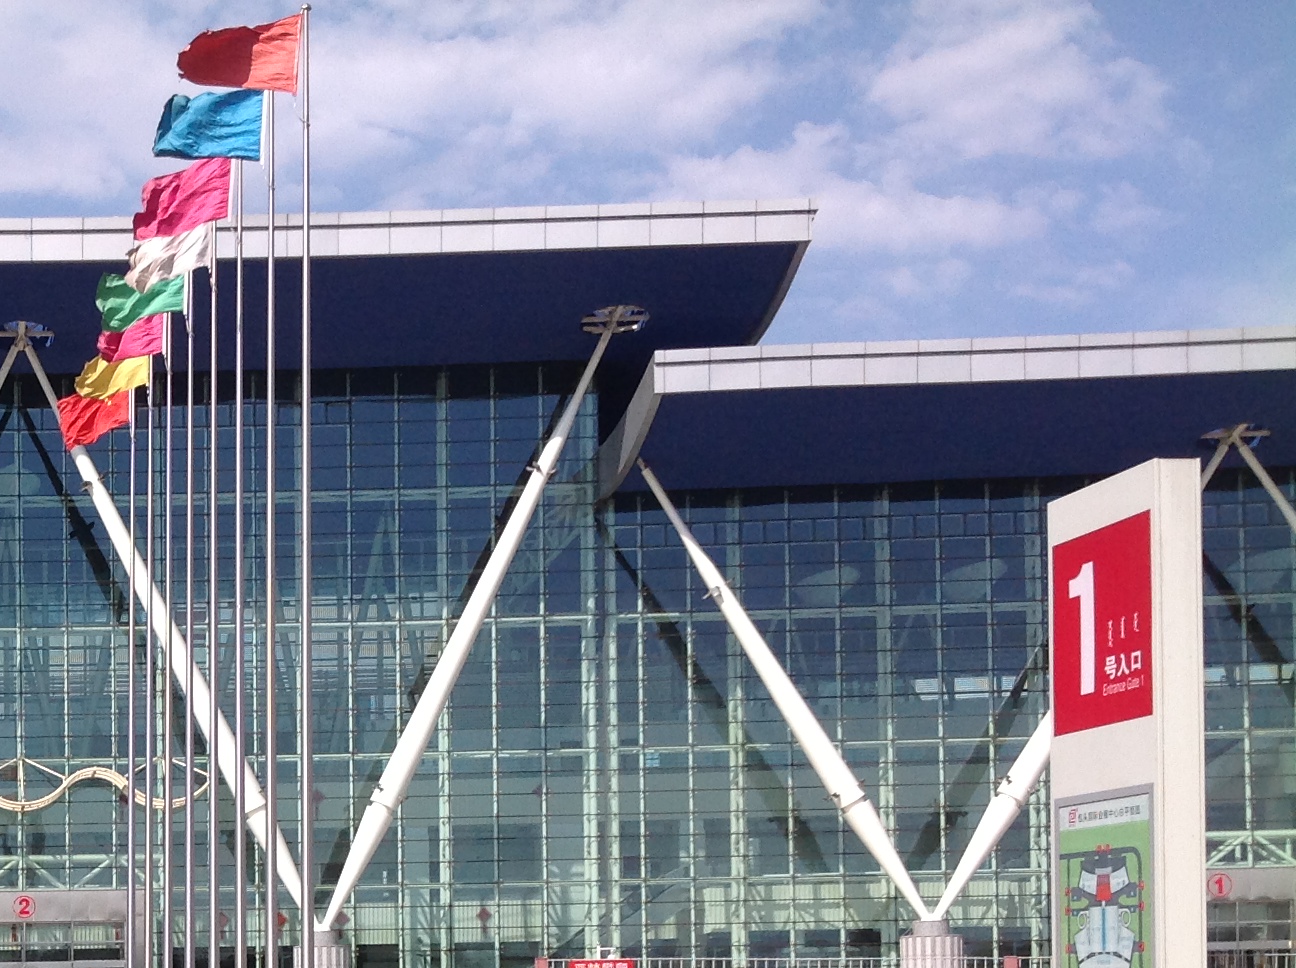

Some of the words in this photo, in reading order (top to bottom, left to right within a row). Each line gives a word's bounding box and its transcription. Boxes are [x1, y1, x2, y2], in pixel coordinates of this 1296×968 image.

[1068, 560, 1096, 696] 1
[1104, 650, 1142, 680] 号入口
[1215, 876, 1224, 894] 1
[18, 898, 30, 915] 2
